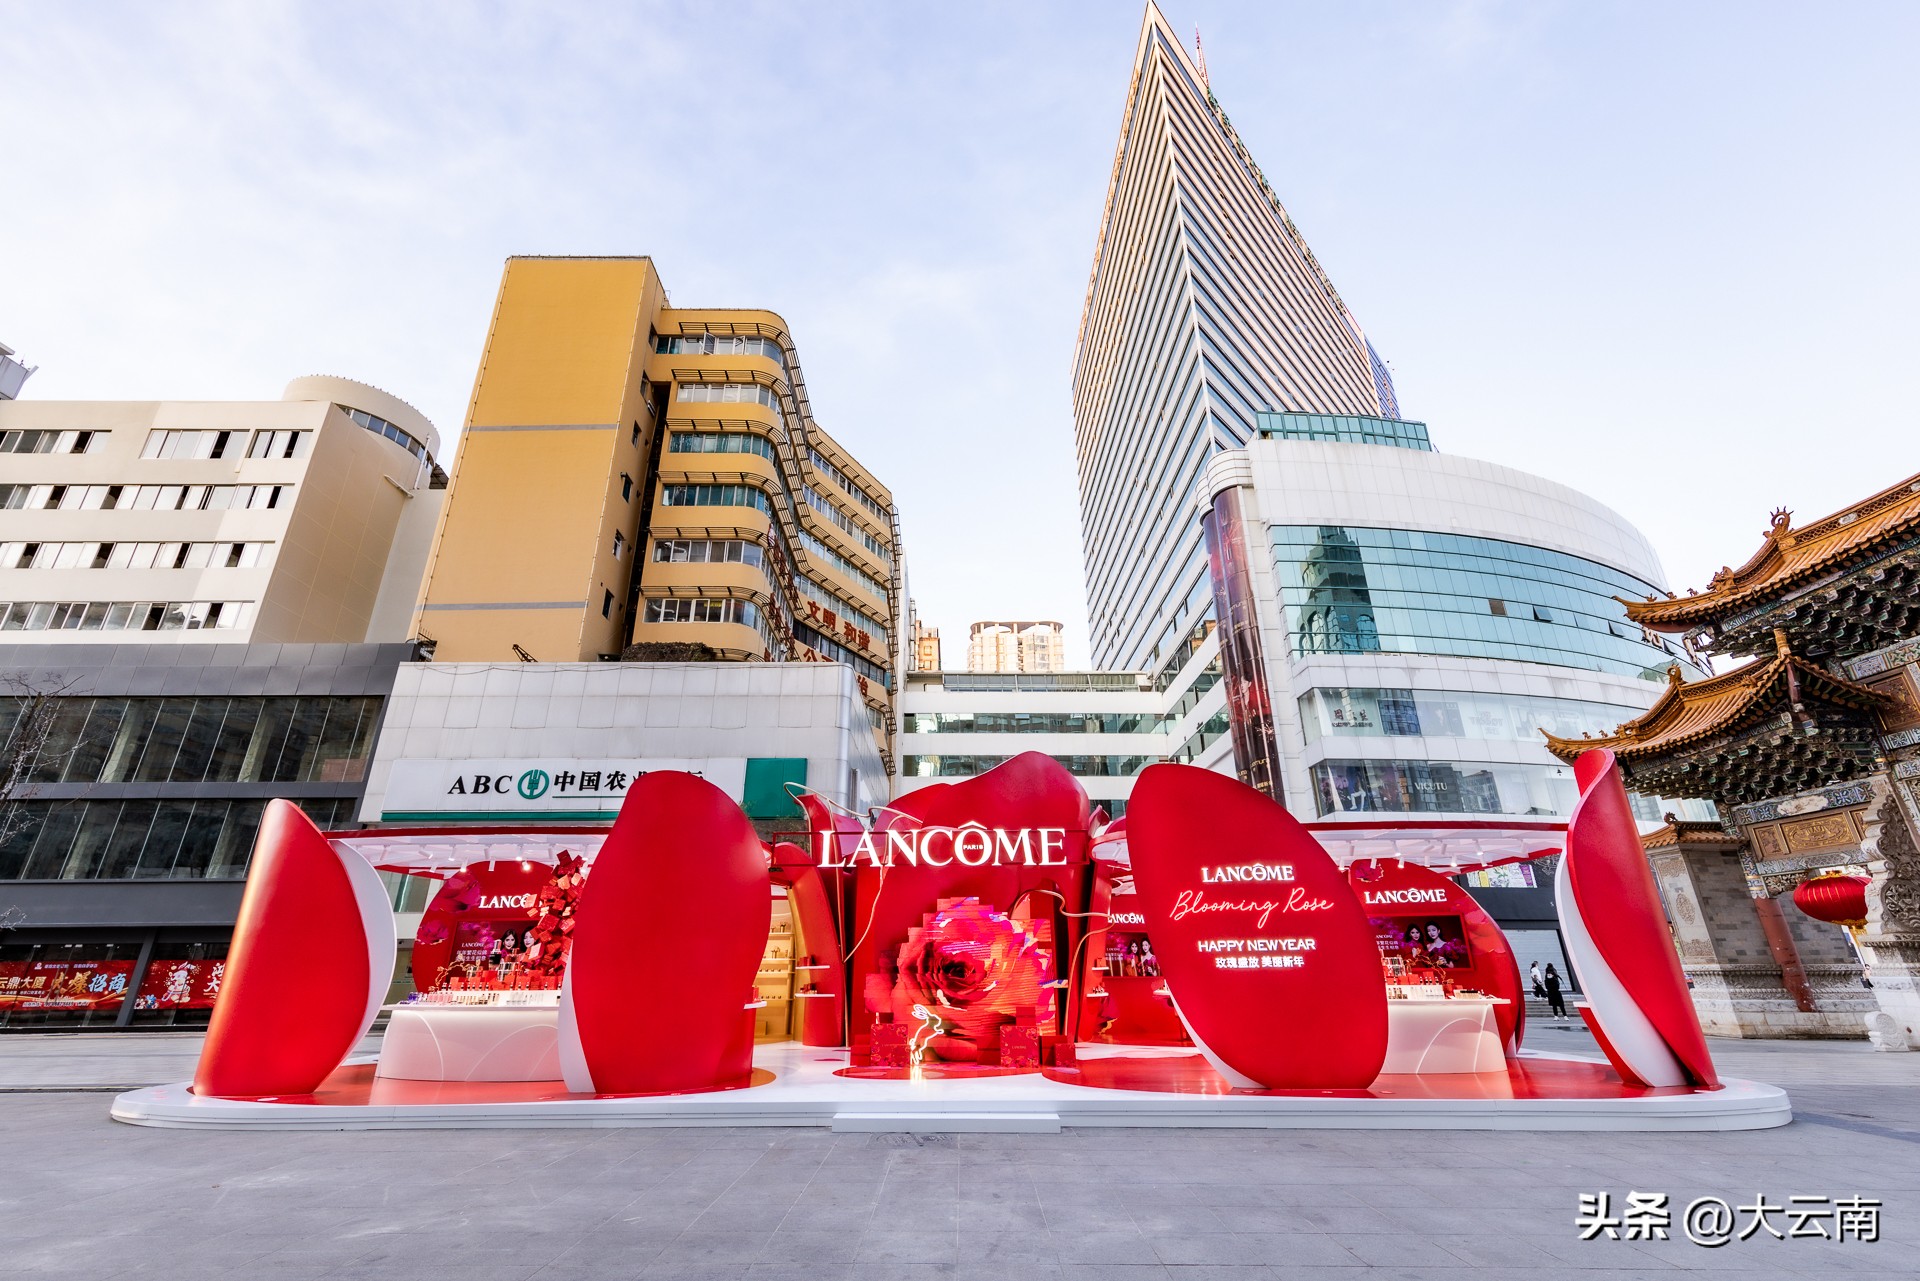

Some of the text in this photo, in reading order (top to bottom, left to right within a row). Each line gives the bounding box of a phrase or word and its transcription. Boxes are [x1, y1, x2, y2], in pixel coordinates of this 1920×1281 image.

[807, 600, 836, 632] 文明
[843, 620, 871, 651] 和谐
[447, 774, 513, 795] ABC
[817, 820, 1067, 868] LANCÔME
[1201, 863, 1295, 883] LANCÔME
[478, 893, 543, 909] LANCÔ
[1364, 888, 1447, 904] LANCÔME
[1169, 887, 1334, 929] Blooming Rose
[1107, 912, 1145, 924] LANCÔM
[1198, 939, 1244, 952] HAPPY
[1215, 955, 1305, 969] 玫瑰盛放 美丽新年
